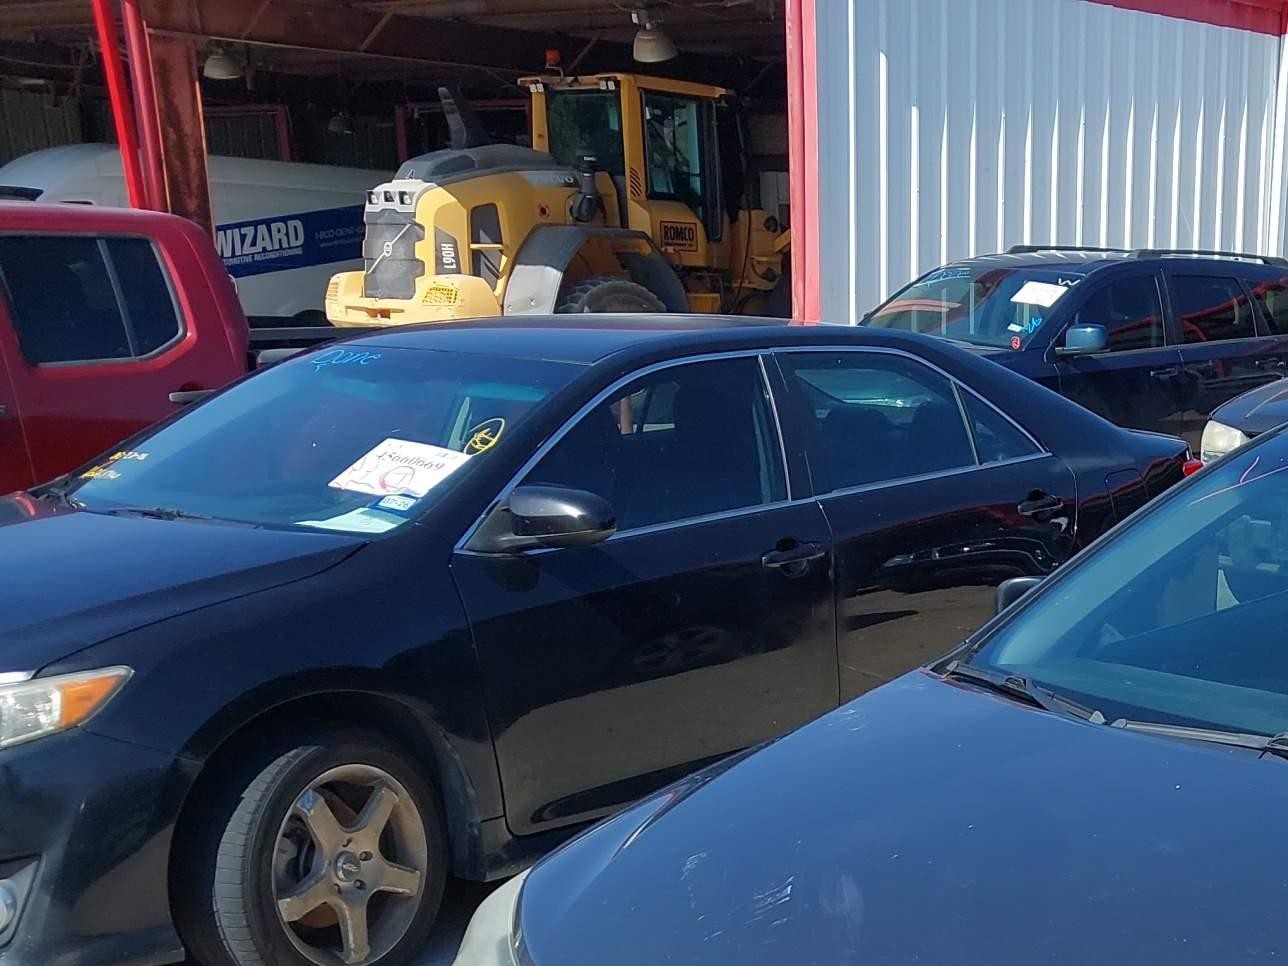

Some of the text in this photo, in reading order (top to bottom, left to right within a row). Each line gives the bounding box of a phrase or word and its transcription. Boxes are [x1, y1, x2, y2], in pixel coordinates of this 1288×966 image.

[216, 219, 304, 257] WIZARD
[664, 225, 694, 241] ROMCO
[440, 243, 457, 269] L90H
